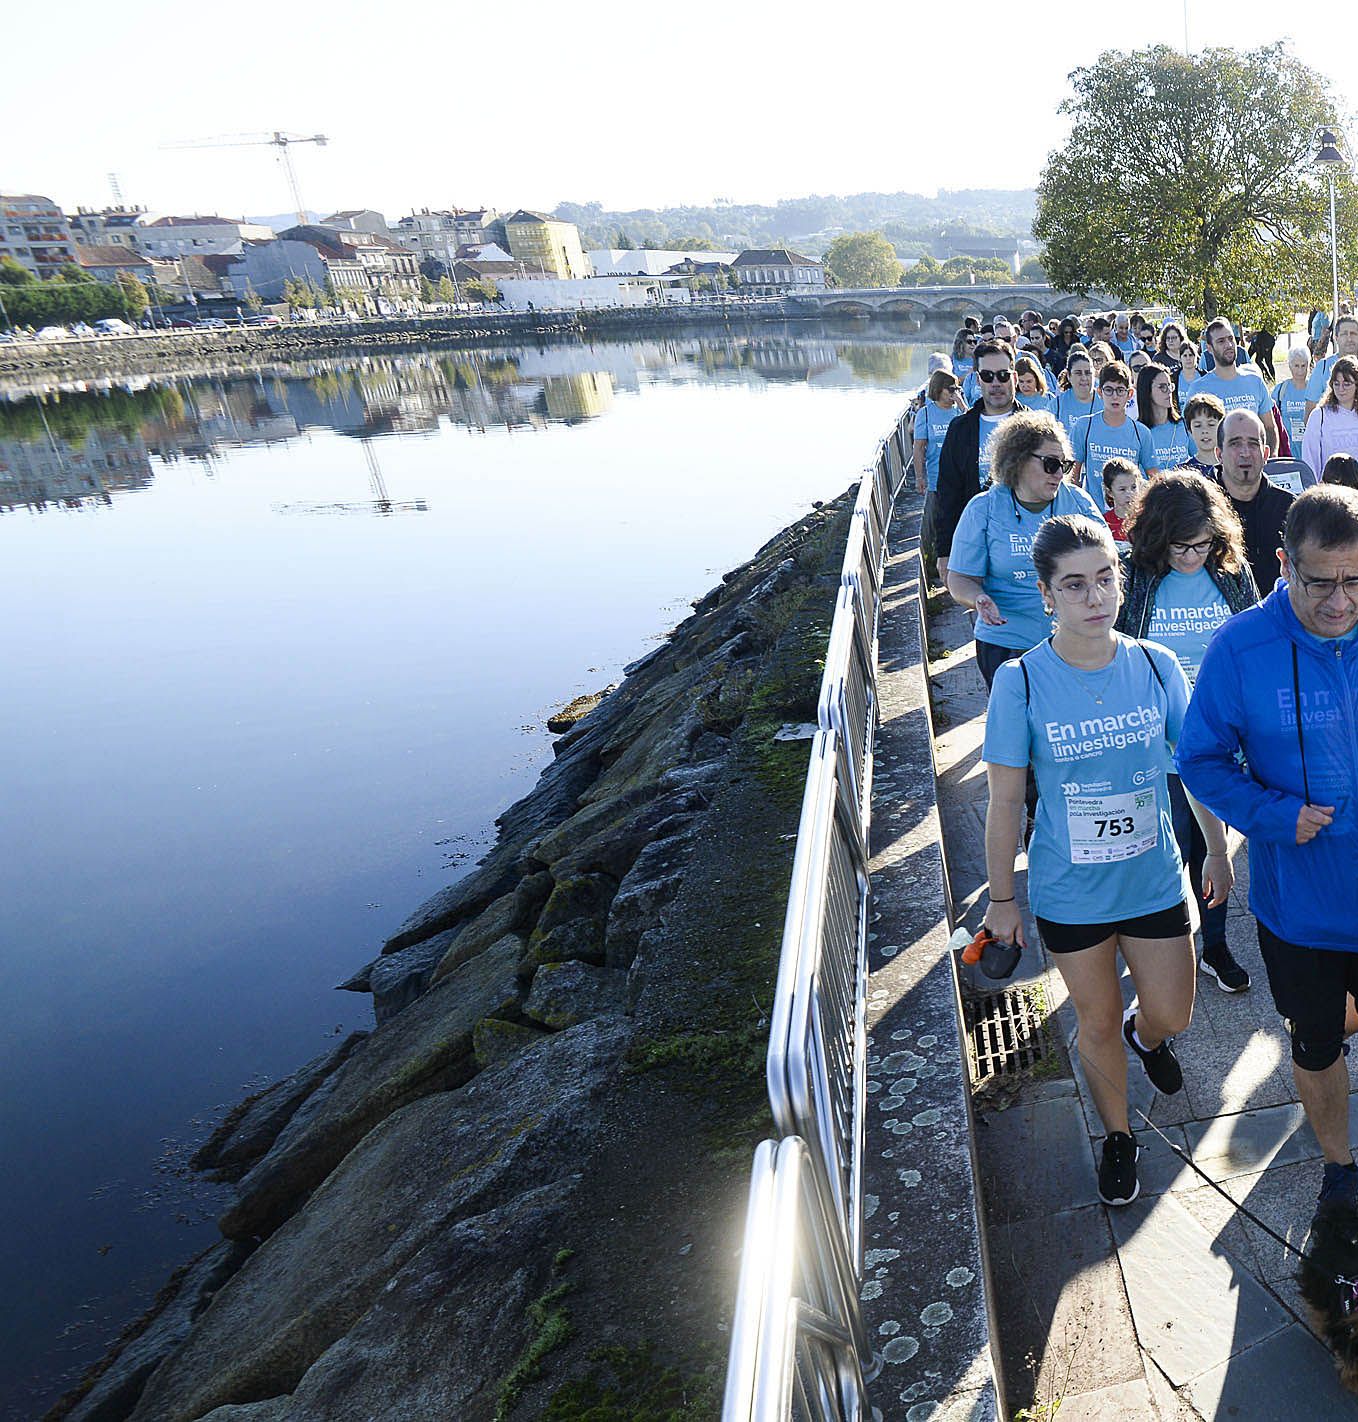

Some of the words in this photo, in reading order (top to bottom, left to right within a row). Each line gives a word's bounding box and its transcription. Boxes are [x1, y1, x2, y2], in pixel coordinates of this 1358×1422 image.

[1090, 442, 1101, 452] En
[1103, 445, 1137, 457] marcha
[1009, 533, 1028, 543] En
[1170, 601, 1232, 620] marcha
[1045, 721, 1076, 742] En
[1080, 705, 1161, 737] marcha
[1068, 798, 1103, 806] Pontevedra
[1083, 808, 1126, 817] investigación
[1094, 816, 1135, 838] 753
